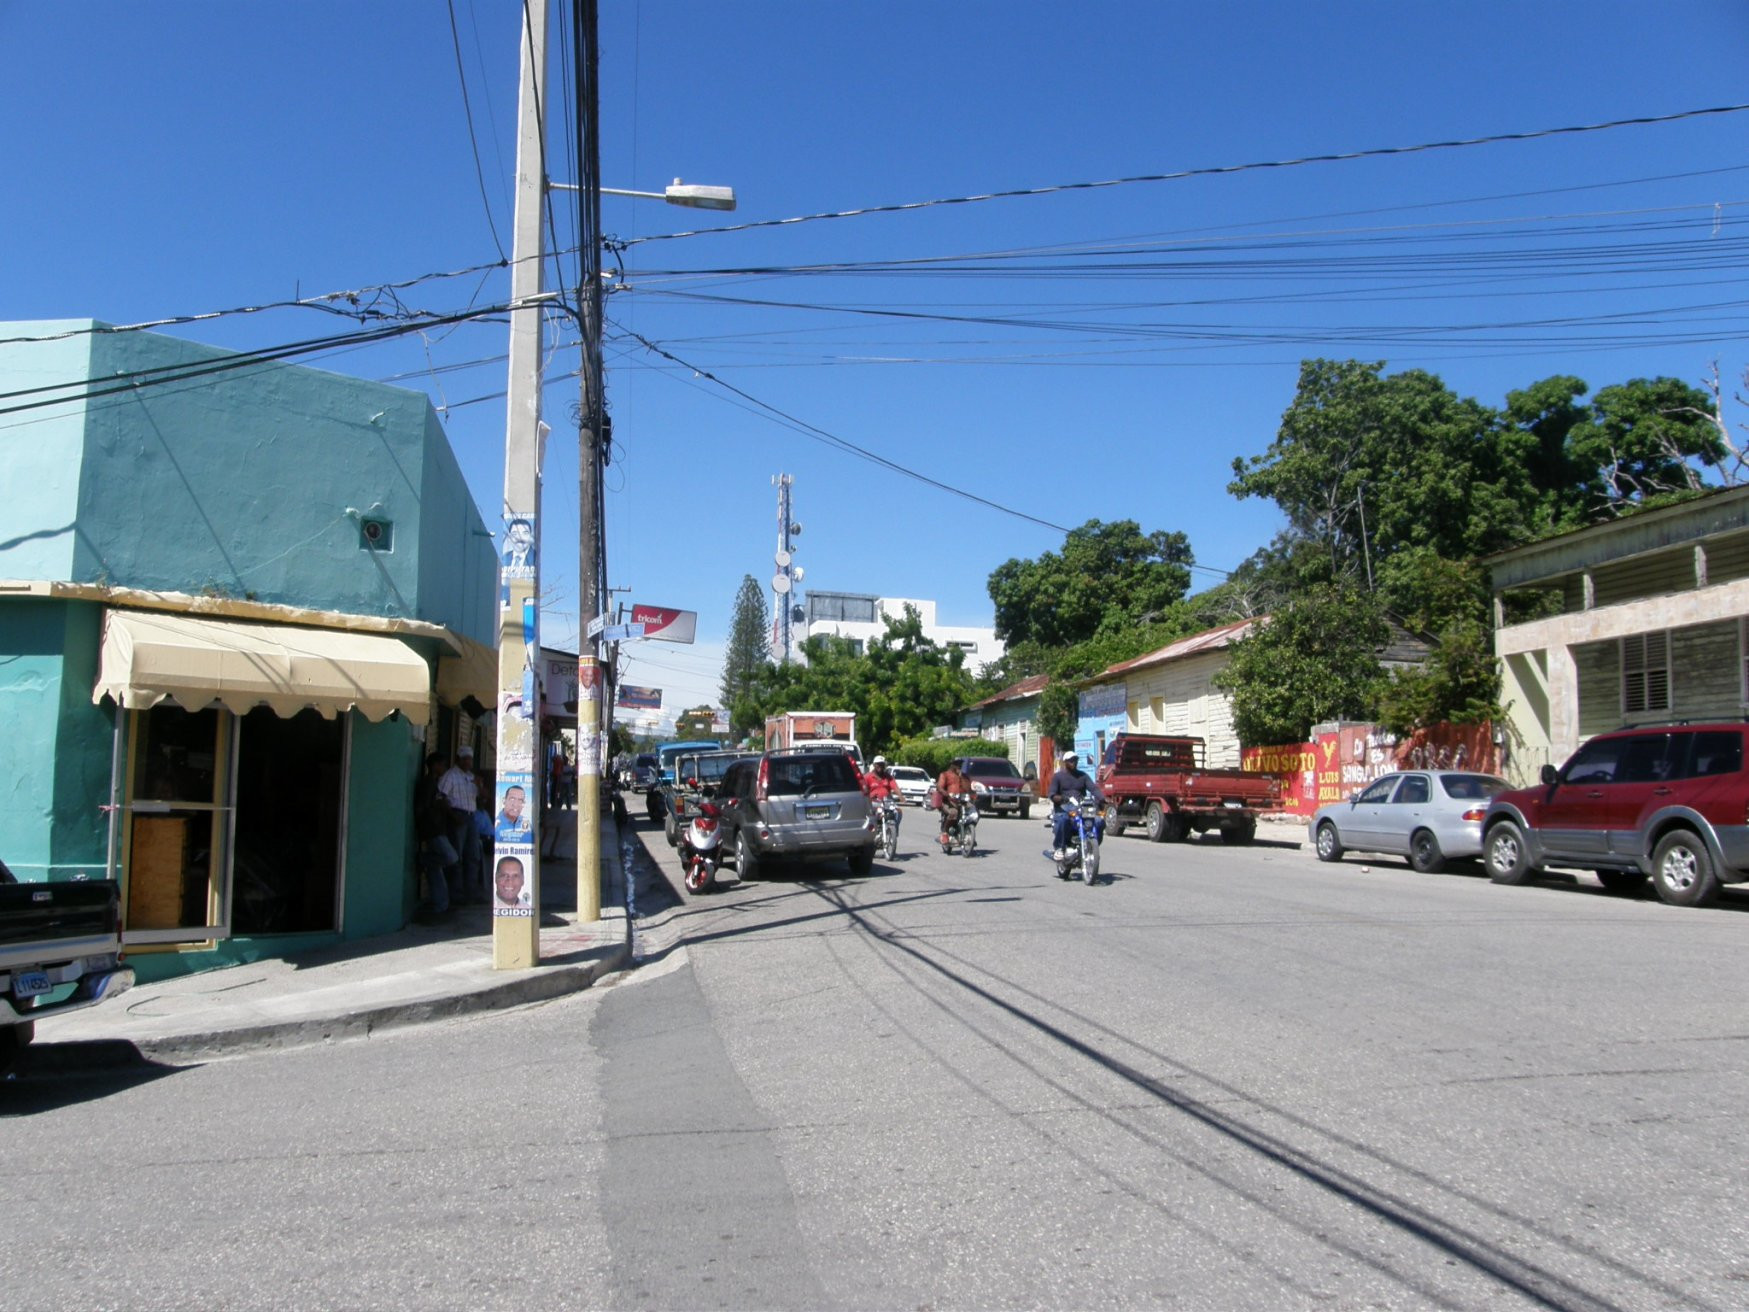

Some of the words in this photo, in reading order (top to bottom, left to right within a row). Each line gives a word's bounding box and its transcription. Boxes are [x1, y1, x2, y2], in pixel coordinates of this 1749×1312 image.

[638, 614, 662, 624] tricom
[1281, 752, 1316, 772] SOTO
[1318, 771, 1339, 784] LUIS
